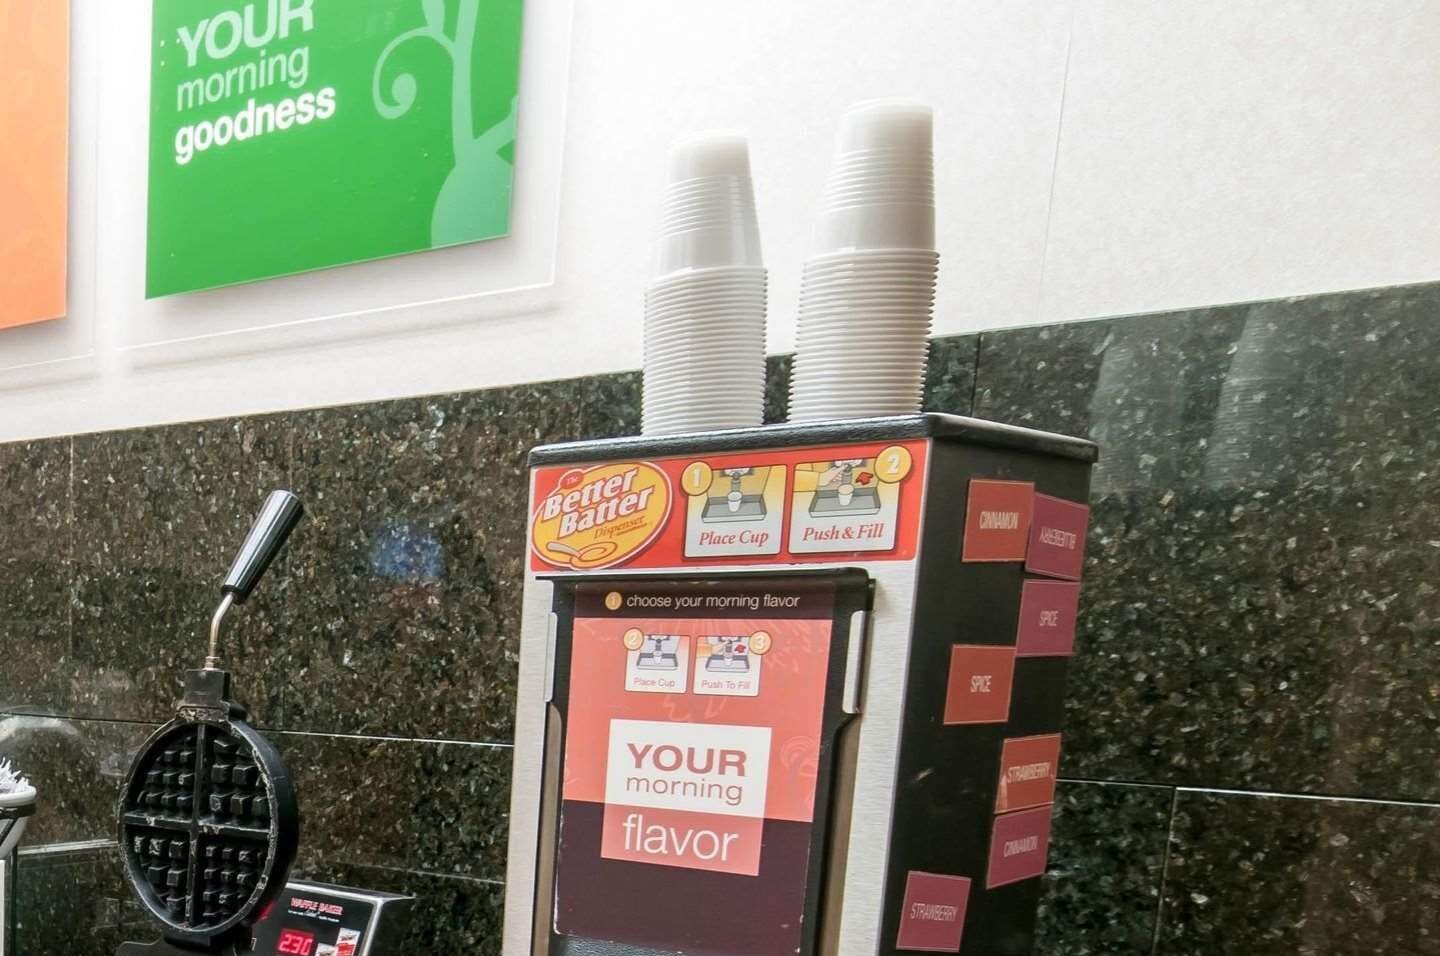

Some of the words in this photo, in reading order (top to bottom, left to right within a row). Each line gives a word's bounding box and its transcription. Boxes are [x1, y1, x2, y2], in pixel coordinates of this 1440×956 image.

[176, 0, 315, 67] YOUR
[177, 46, 309, 112] morning
[175, 86, 336, 165] goodness
[887, 454, 901, 475] 2
[692, 469, 702, 489] 1
[542, 467, 639, 522] Better
[557, 485, 656, 539] Batter
[979, 511, 1019, 529] CINNAMON
[699, 531, 736, 546] Place
[739, 530, 769, 547] Cup
[803, 526, 839, 541] Push
[841, 527, 854, 540] &
[857, 523, 885, 538] Fill
[626, 594, 672, 607] choose
[674, 596, 703, 609] your
[706, 594, 759, 610] morning
[763, 594, 800, 608] flavor
[1039, 610, 1058, 627] SPICE
[633, 677, 657, 687] Place
[658, 677, 676, 688] Cup
[701, 679, 723, 689] Push
[725, 680, 736, 690] To
[738, 681, 751, 690] Fill
[970, 675, 992, 693] SPICE
[626, 743, 748, 777] YOUR
[1007, 762, 1051, 783] STRAWBERRY
[625, 775, 744, 806] morning
[622, 813, 740, 862] flavor
[1003, 835, 1039, 857] CINNAMON
[911, 902, 958, 921] STRAWBERRY
